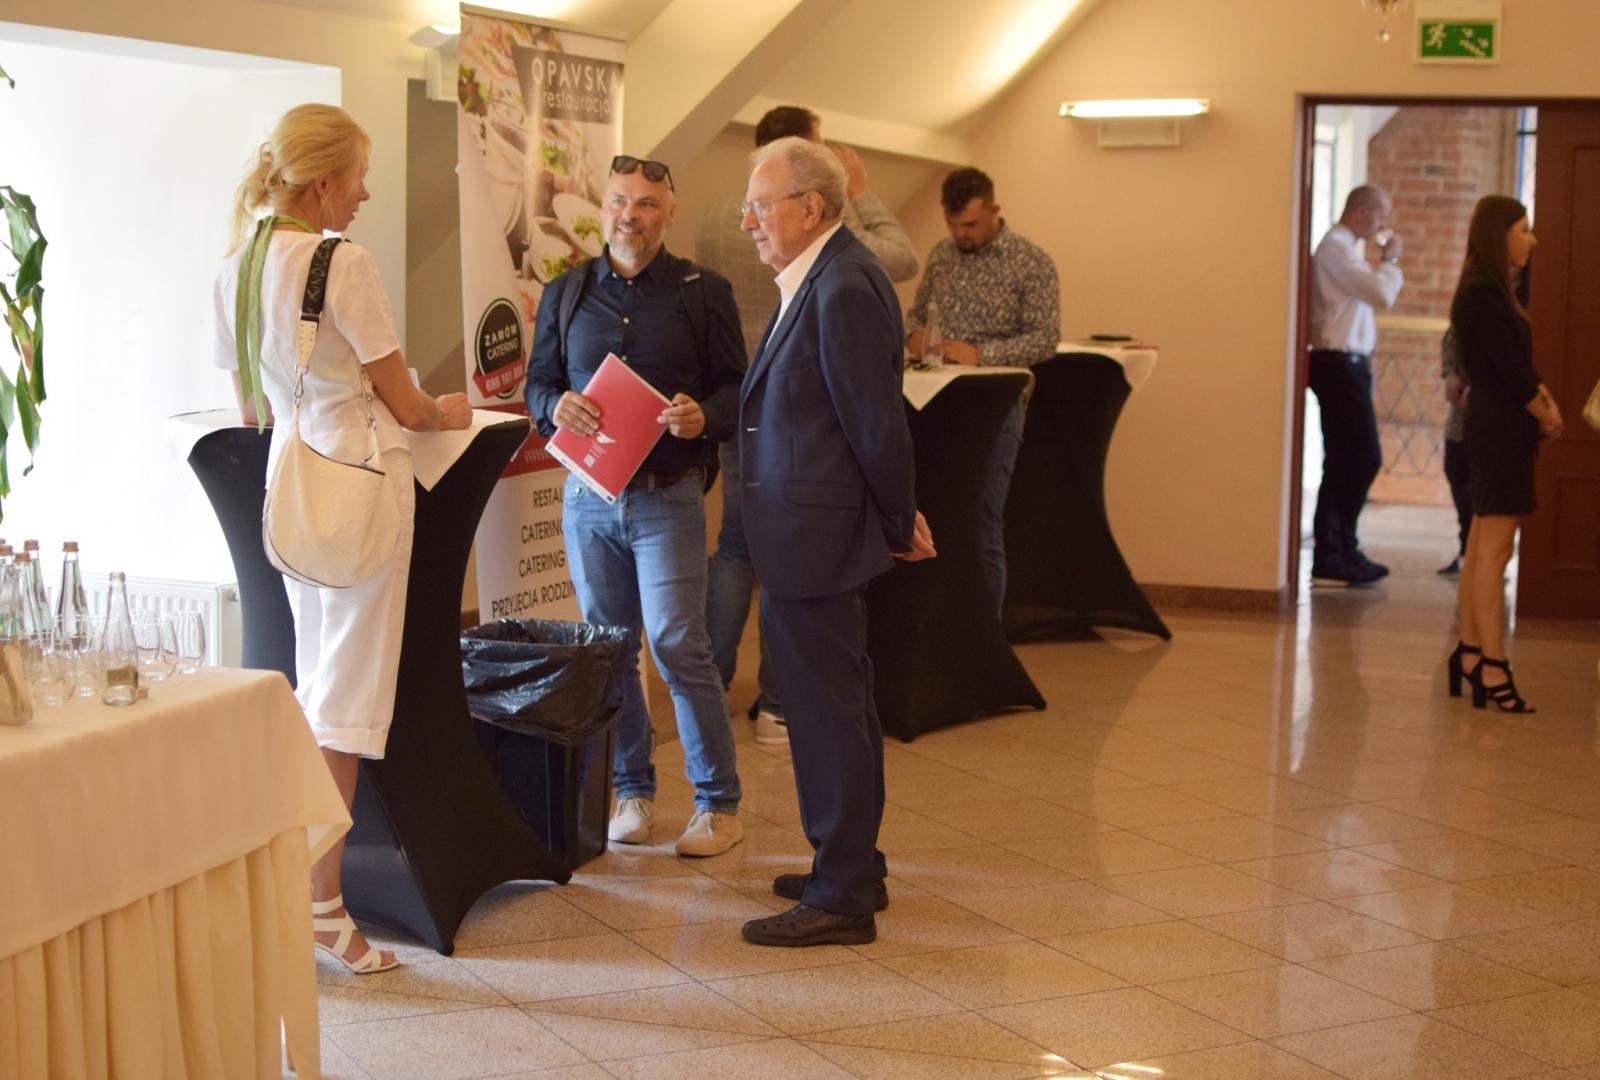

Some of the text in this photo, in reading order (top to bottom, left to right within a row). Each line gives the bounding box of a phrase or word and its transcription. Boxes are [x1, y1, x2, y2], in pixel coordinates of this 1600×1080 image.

[543, 91, 610, 119] restauracja
[484, 323, 518, 347] ZAMÓW
[487, 337, 519, 361] CATERING
[518, 550, 565, 578] CATERING
[492, 588, 540, 619] PRZYJĘCIA
